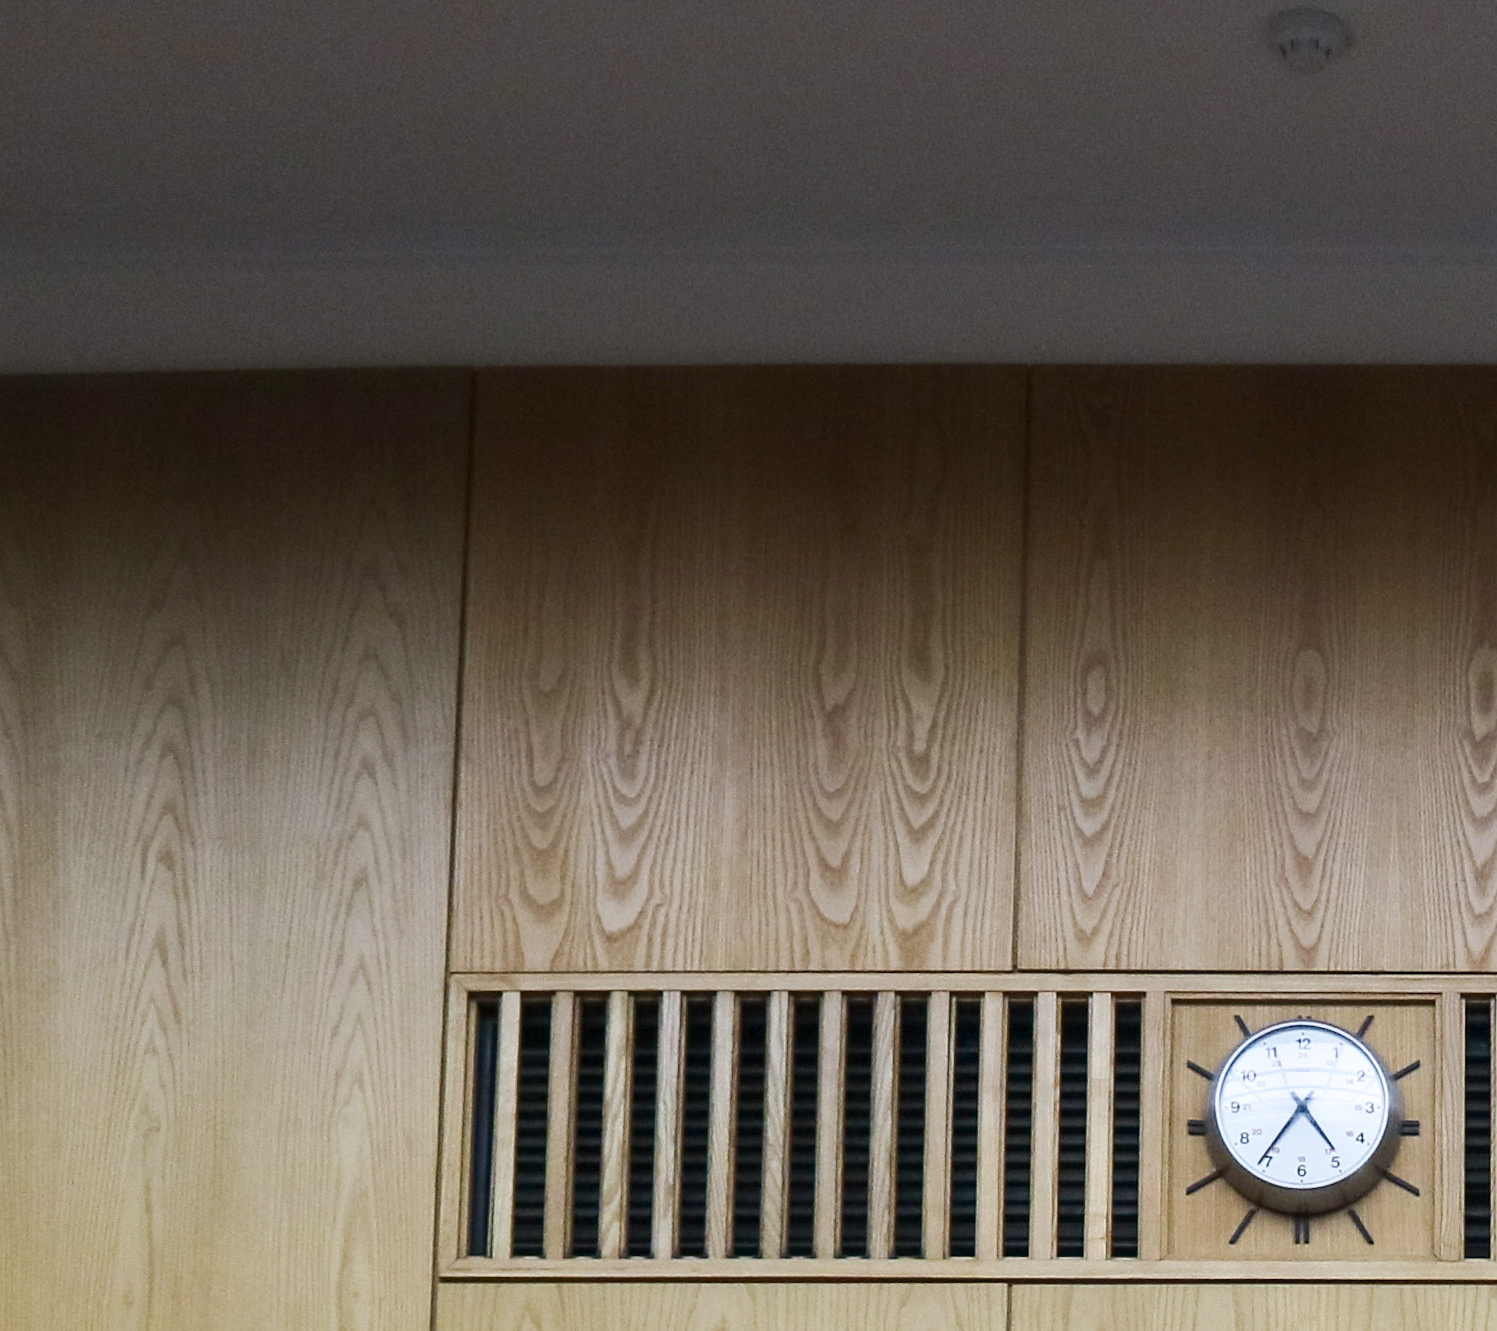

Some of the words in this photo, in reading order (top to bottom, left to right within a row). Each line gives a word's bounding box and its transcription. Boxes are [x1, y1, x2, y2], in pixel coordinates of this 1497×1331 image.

[1296, 1038, 1311, 1051] 12
[1265, 1046, 1278, 1058] 11
[1332, 1046, 1339, 1058] 1
[1240, 1070, 1257, 1082] 10
[1356, 1070, 1366, 1082] 2
[1230, 1101, 1241, 1114] 9
[1365, 1101, 1375, 1114] 3
[1239, 1131, 1250, 1145] 8
[1355, 1131, 1366, 1144] 4
[1263, 1154, 1274, 1168] 7
[1330, 1156, 1341, 1169] 5
[1297, 1164, 1307, 1177] 6
